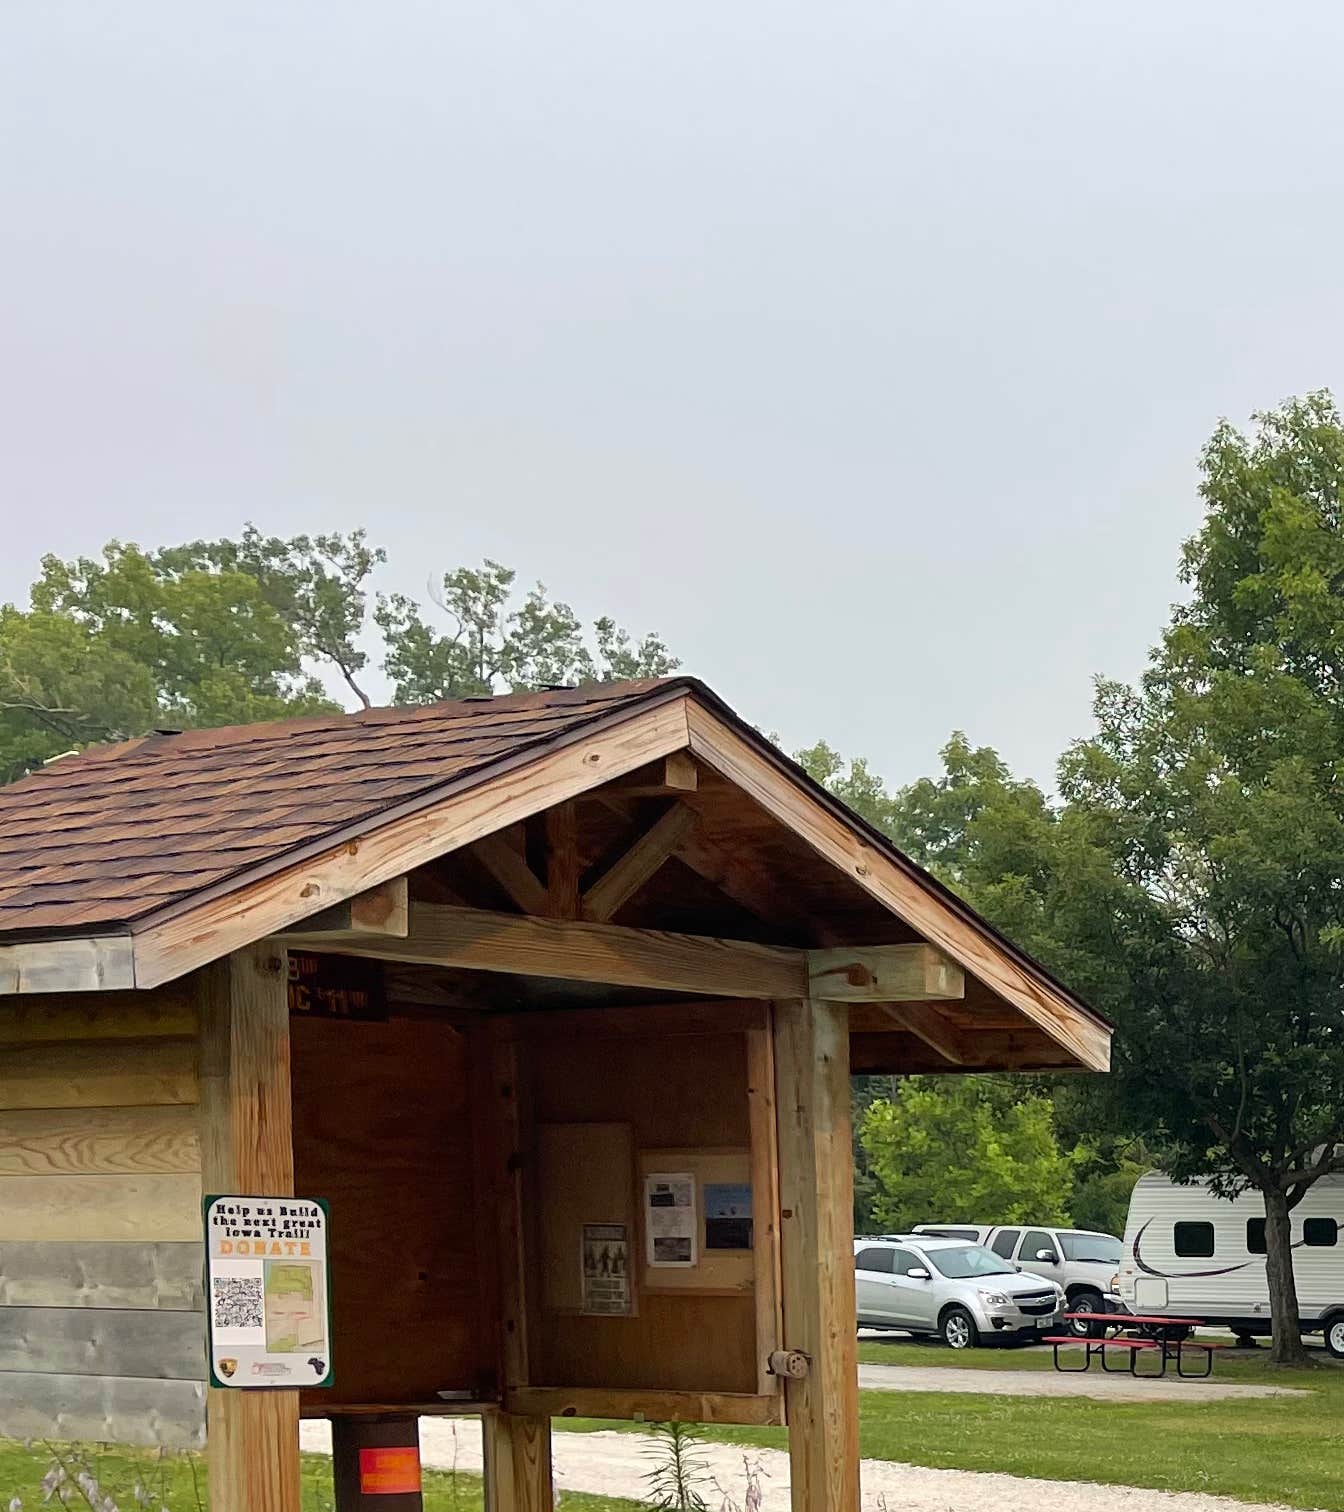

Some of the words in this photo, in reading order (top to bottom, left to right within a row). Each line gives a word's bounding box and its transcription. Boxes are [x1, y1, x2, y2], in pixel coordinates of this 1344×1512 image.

[216, 1204, 250, 1217] Help
[256, 1207, 273, 1216] us
[280, 1206, 318, 1217] Build
[213, 1216, 237, 1226] the
[243, 1218, 276, 1227] next
[283, 1219, 321, 1229] great
[225, 1227, 262, 1238] Iowa
[220, 1240, 311, 1255] DONATE
